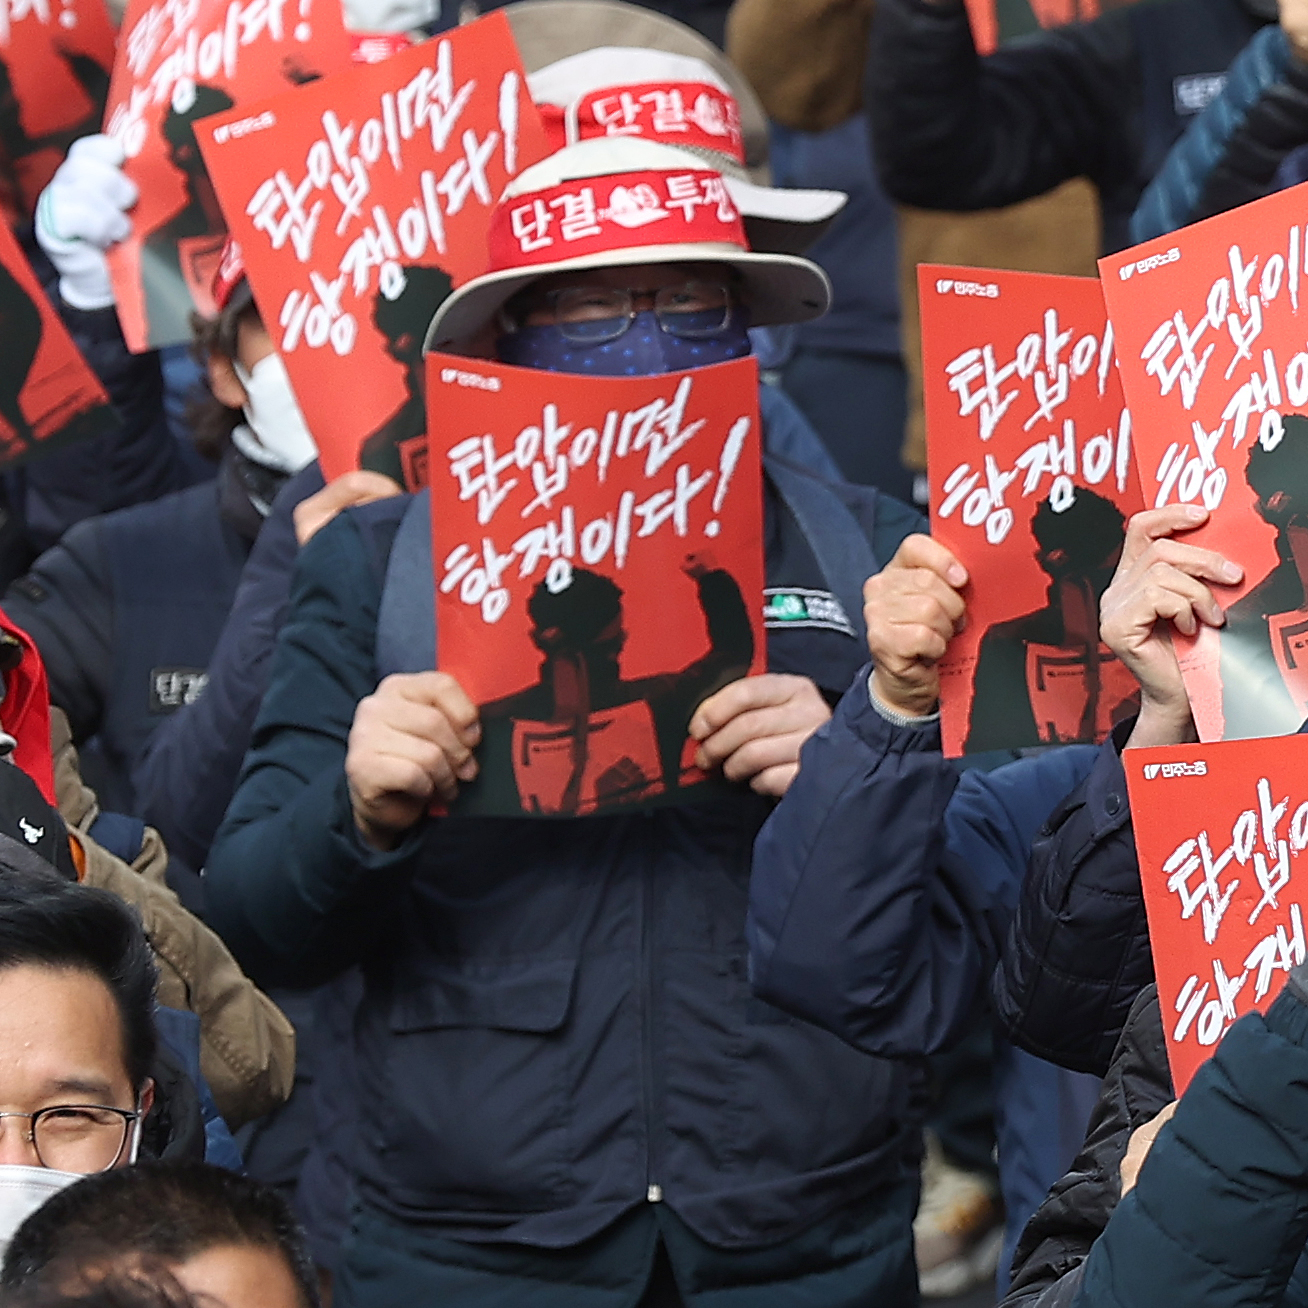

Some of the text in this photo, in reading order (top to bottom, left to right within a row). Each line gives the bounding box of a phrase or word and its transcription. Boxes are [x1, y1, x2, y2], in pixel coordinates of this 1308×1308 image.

[247, 39, 479, 263] 탄압이면
[593, 87, 686, 137] 단결
[281, 70, 520, 355] 항쟁이다!
[509, 188, 603, 253] 단결
[1135, 247, 1181, 274] 민주노총
[946, 308, 1118, 442] 탄압이
[448, 376, 705, 524] 탄압이면
[441, 416, 751, 623] 항쟁이다!
[1161, 760, 1207, 778] 민주노총
